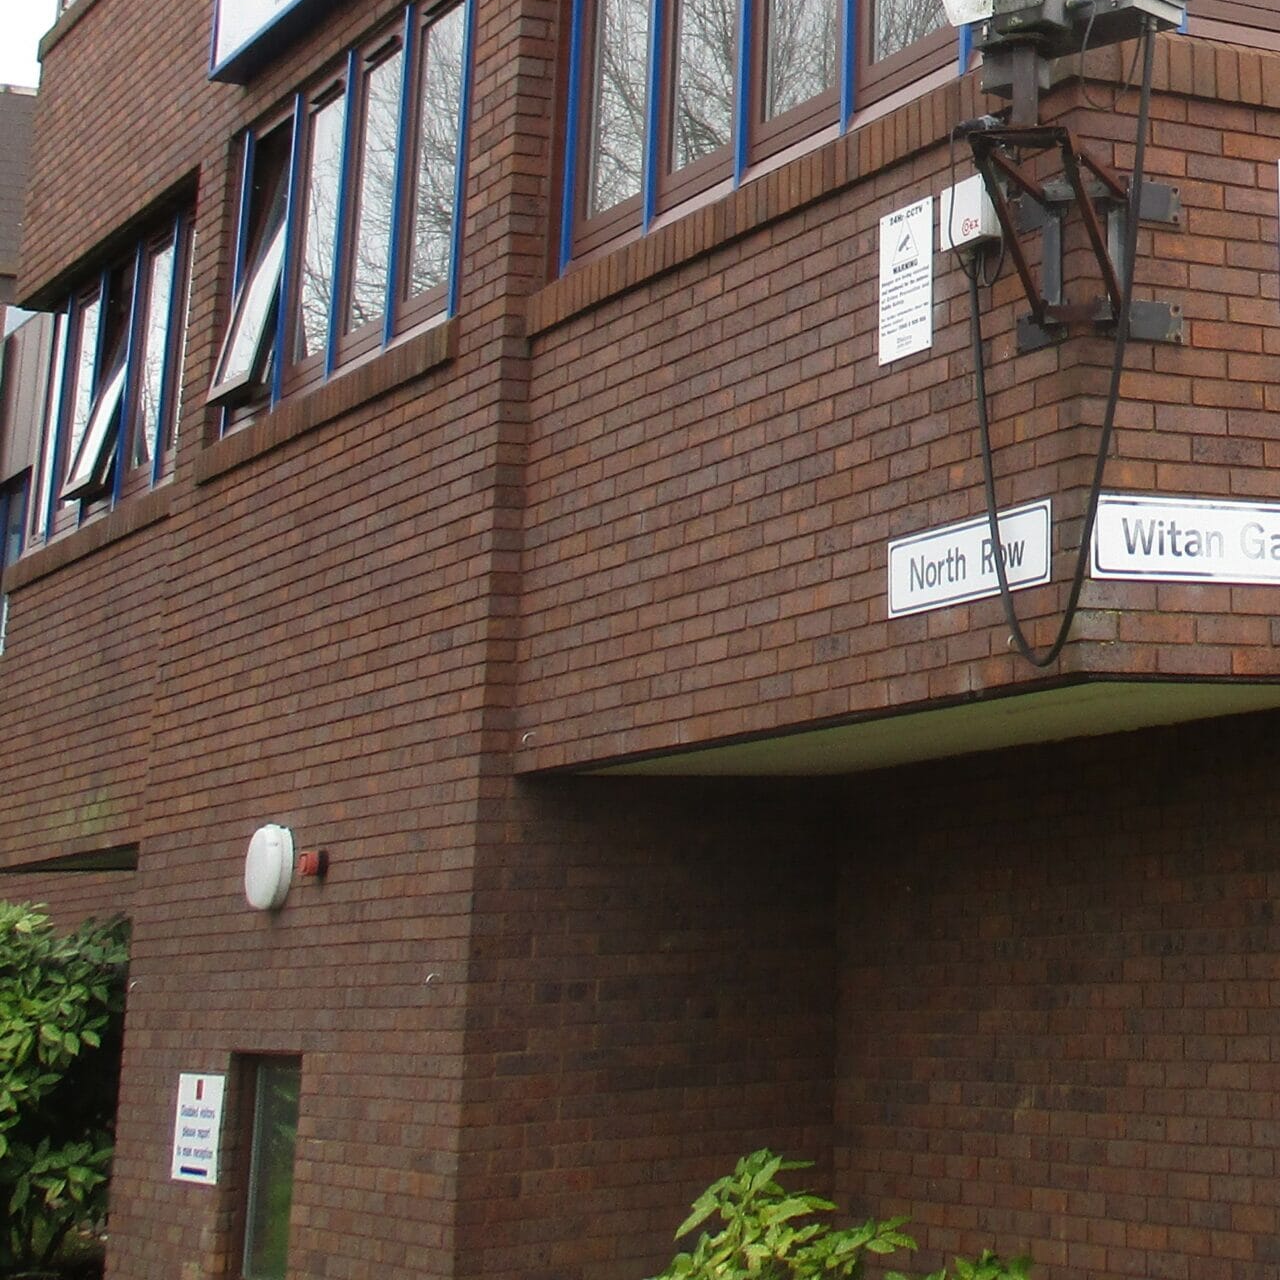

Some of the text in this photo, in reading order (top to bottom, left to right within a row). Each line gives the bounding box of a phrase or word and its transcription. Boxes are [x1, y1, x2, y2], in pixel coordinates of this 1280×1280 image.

[905, 204, 923, 219] CCTV
[1122, 517, 1225, 559] Witan
[909, 544, 967, 593] North
